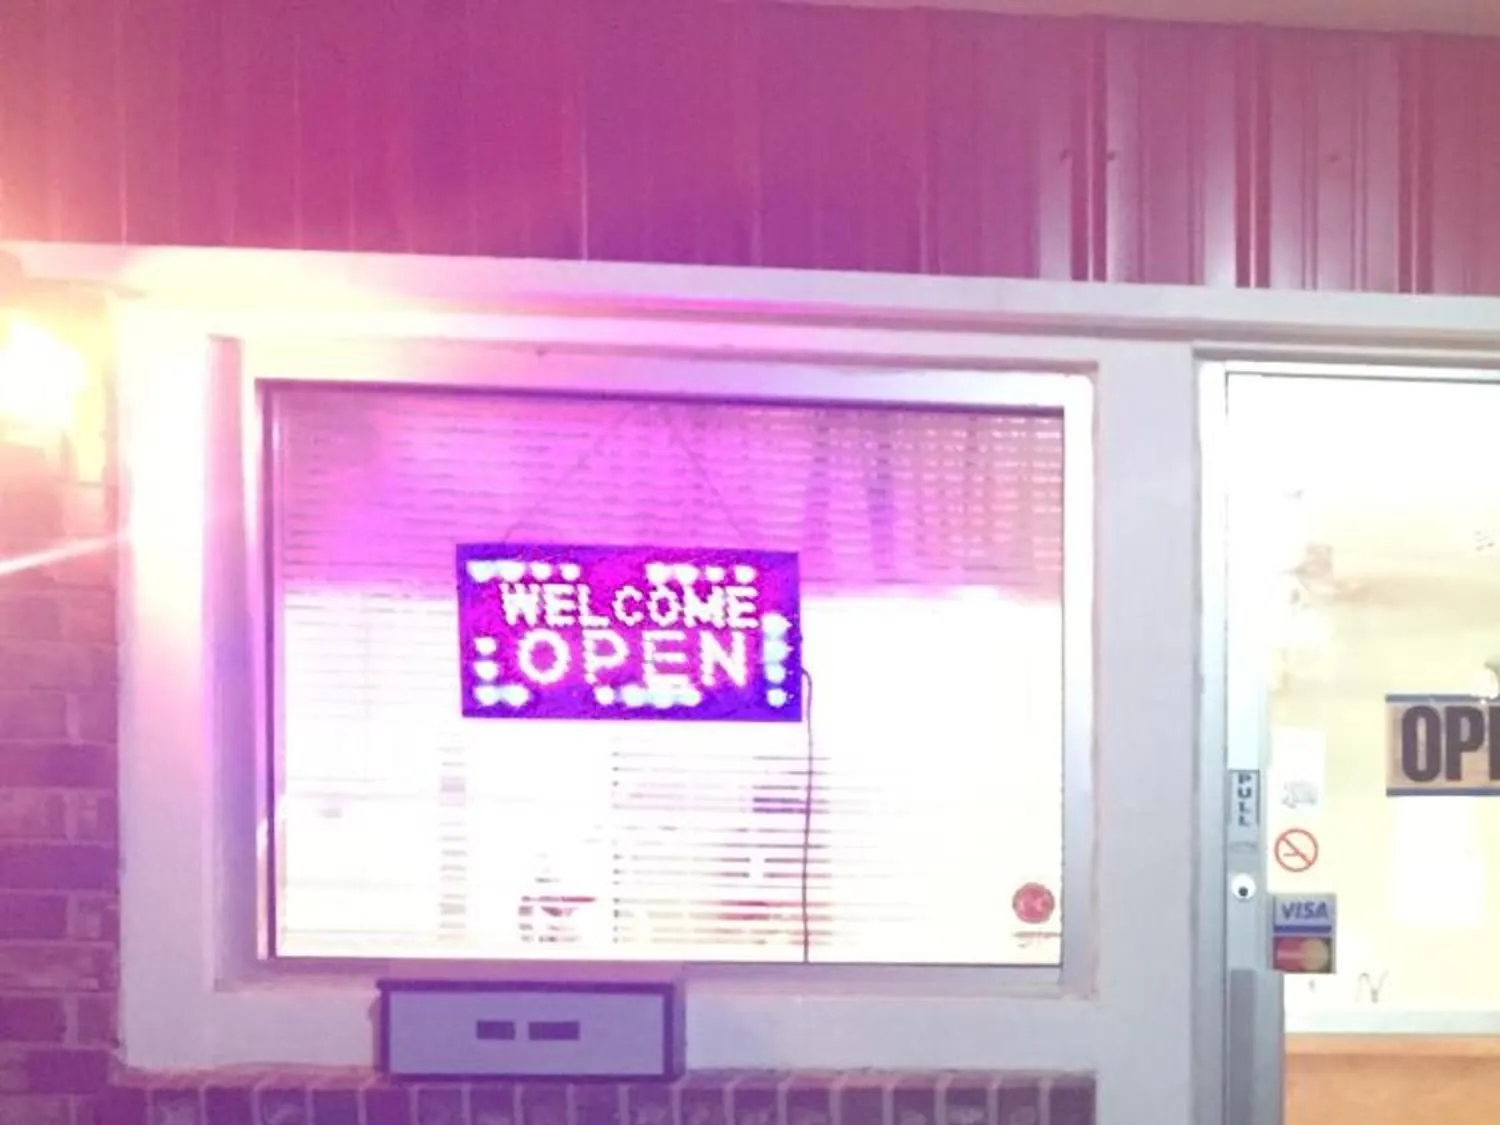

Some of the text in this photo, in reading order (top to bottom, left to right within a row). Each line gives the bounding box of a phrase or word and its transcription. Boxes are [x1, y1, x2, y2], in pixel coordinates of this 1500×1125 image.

[500, 582, 760, 628] WELCOME
[517, 629, 750, 688] OPEN
[1237, 773, 1253, 827] PULL
[1281, 901, 1330, 920] VISA
